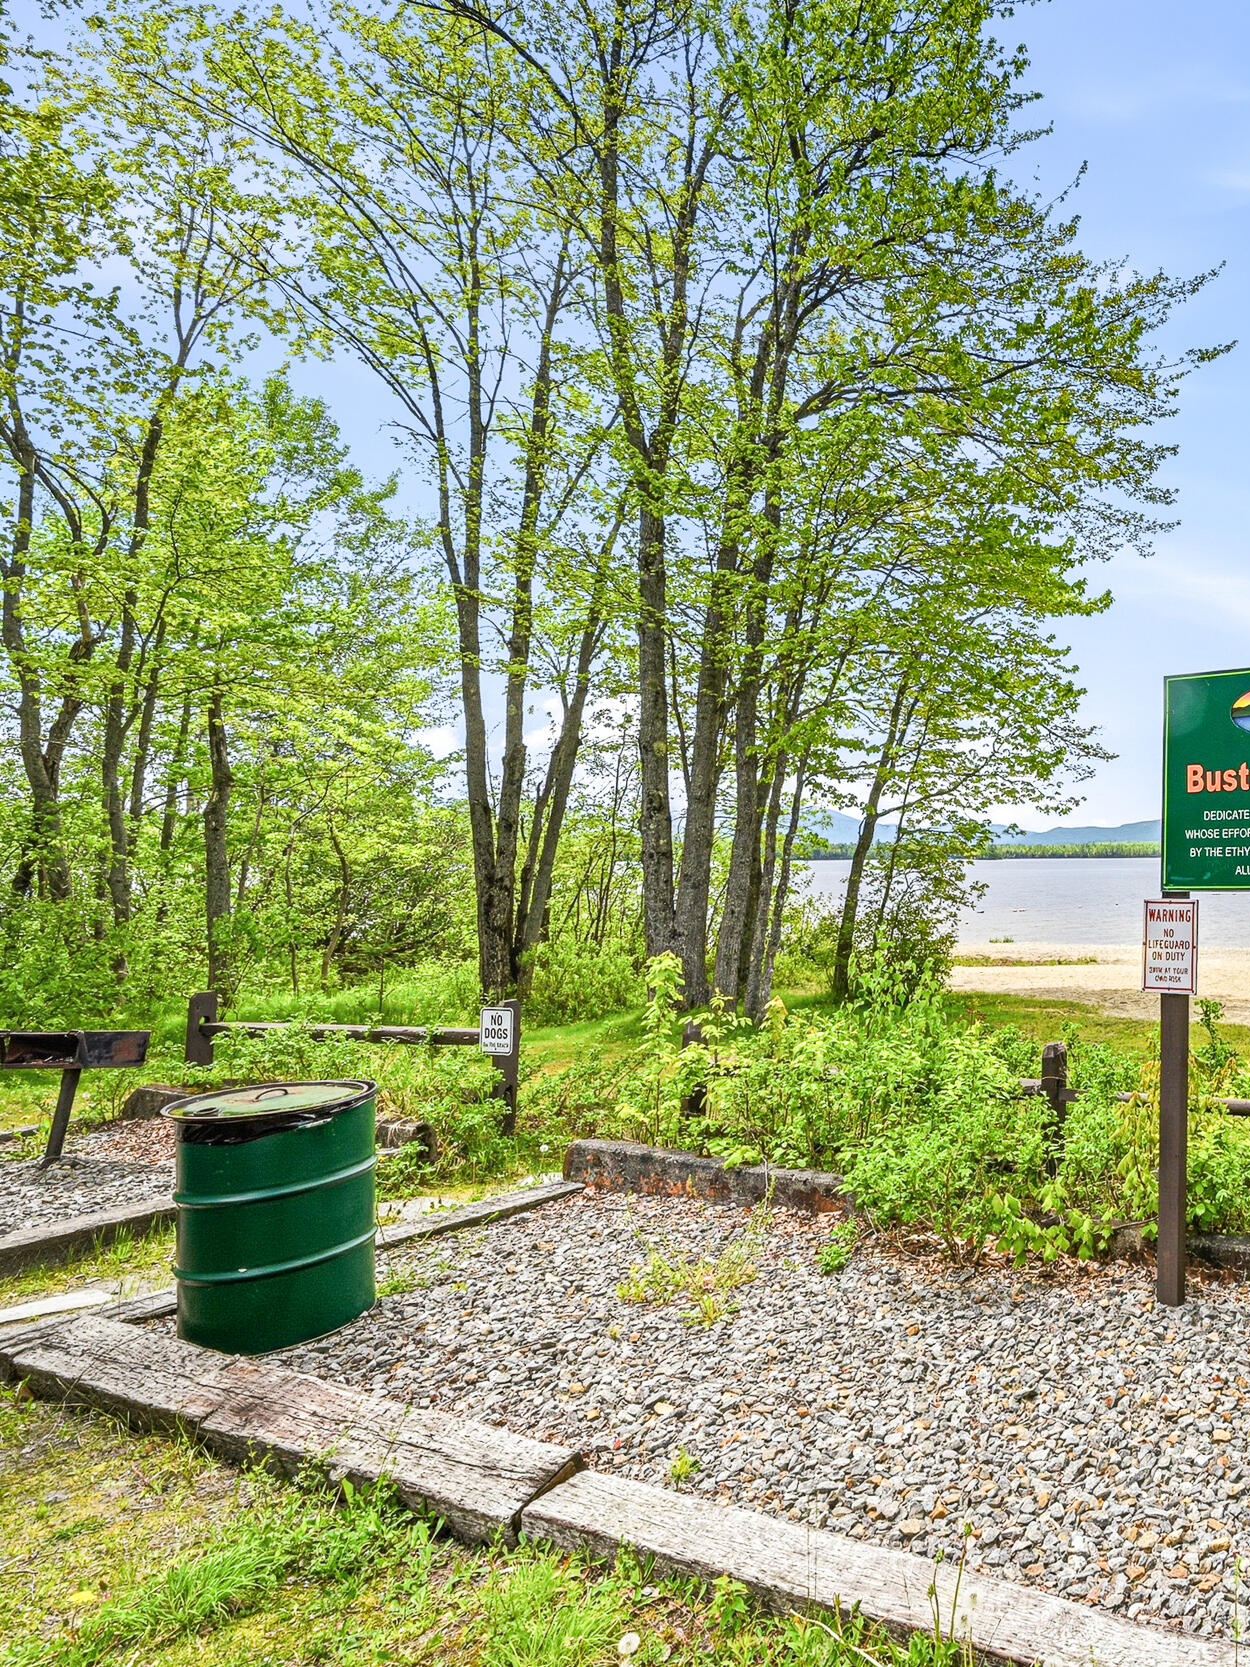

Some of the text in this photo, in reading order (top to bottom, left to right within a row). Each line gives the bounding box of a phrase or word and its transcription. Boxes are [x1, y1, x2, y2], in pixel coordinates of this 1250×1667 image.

[1185, 828, 1220, 839] WHOSE
[1190, 847, 1202, 857] BY
[1204, 847, 1223, 857] THE
[1149, 909, 1191, 922] WARNING
[1163, 929, 1174, 938] NO
[1148, 940, 1190, 950] LIFEGUARD
[1152, 952, 1185, 961] ON DUTY
[1173, 967, 1188, 975] YOUR
[491, 1014, 503, 1026] NO
[485, 1028, 508, 1039] DOGS
